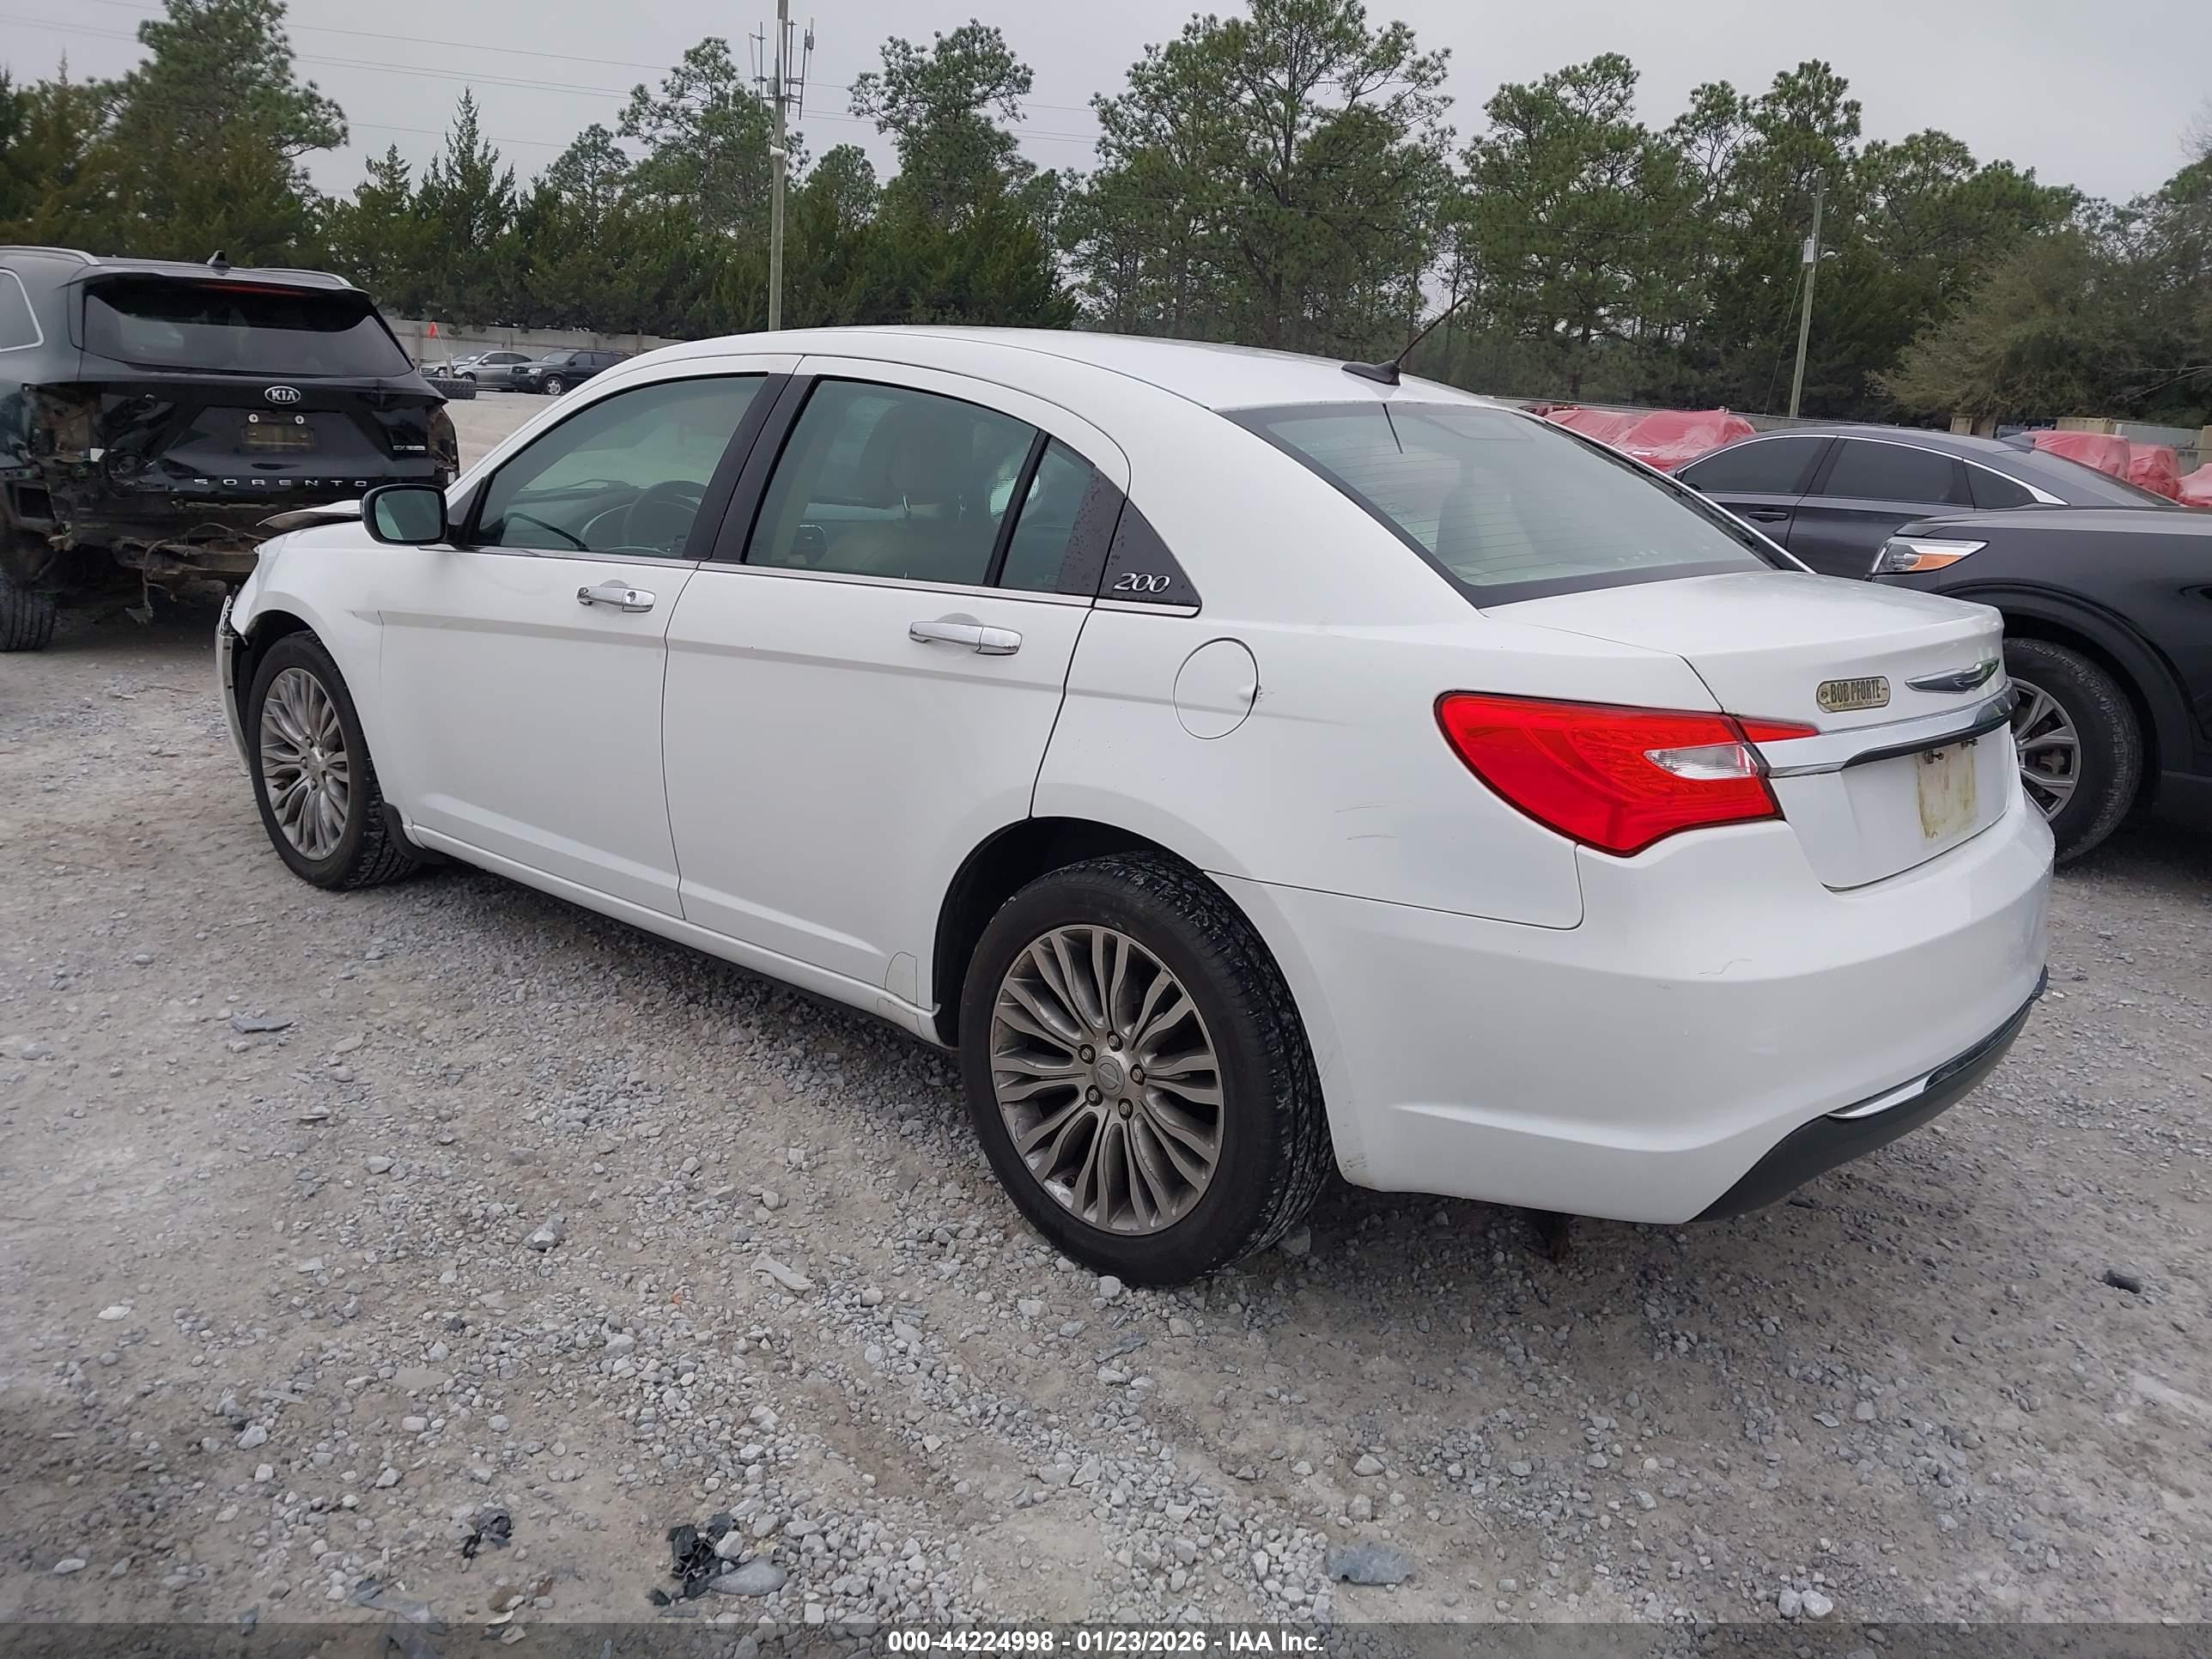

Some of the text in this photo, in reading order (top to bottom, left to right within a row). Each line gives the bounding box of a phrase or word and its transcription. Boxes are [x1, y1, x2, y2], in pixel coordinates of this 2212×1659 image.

[270, 390, 296, 401] KIA
[193, 478, 368, 487] SORENTO
[1113, 572, 1170, 592] 200
[1830, 679, 1881, 703] BOB PFORTE
